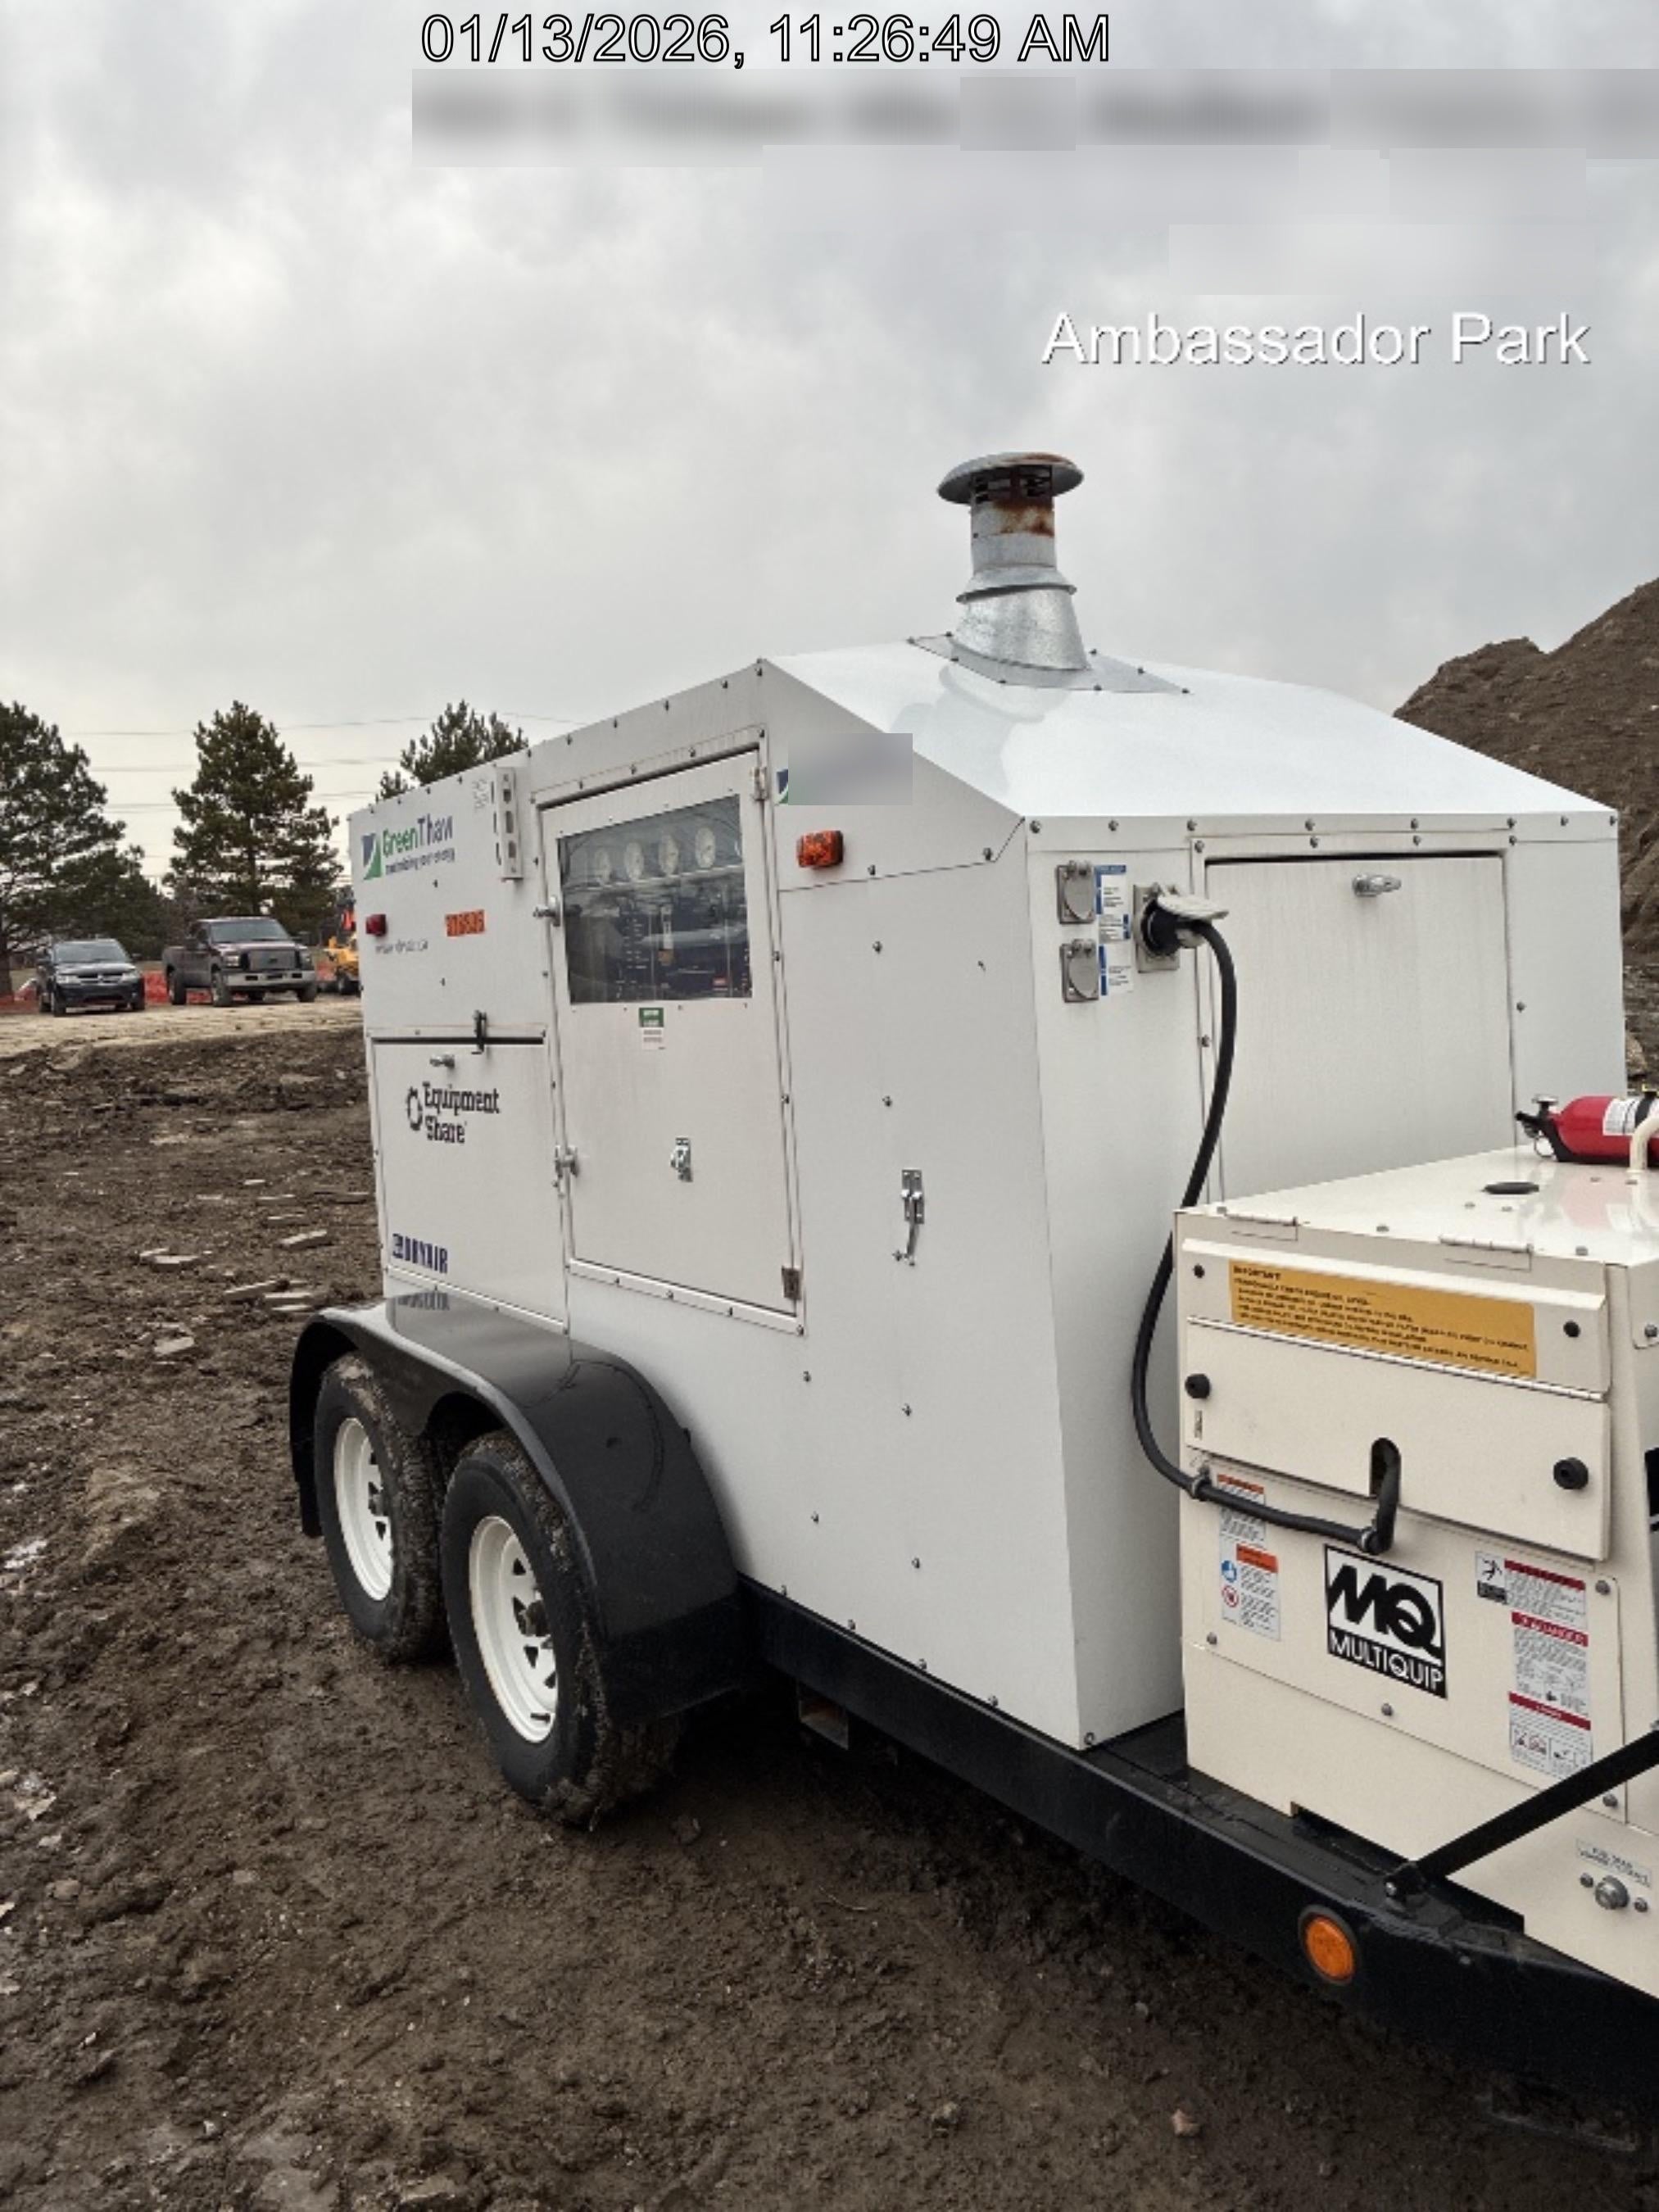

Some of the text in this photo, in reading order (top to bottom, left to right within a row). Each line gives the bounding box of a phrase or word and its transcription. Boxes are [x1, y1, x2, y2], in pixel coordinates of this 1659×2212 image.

[423, 1081, 500, 1116] Equipment
[425, 1115, 465, 1144] Share
[1327, 1563, 1442, 1655] MQ
[1330, 1629, 1444, 1690] MULTIQUIP
